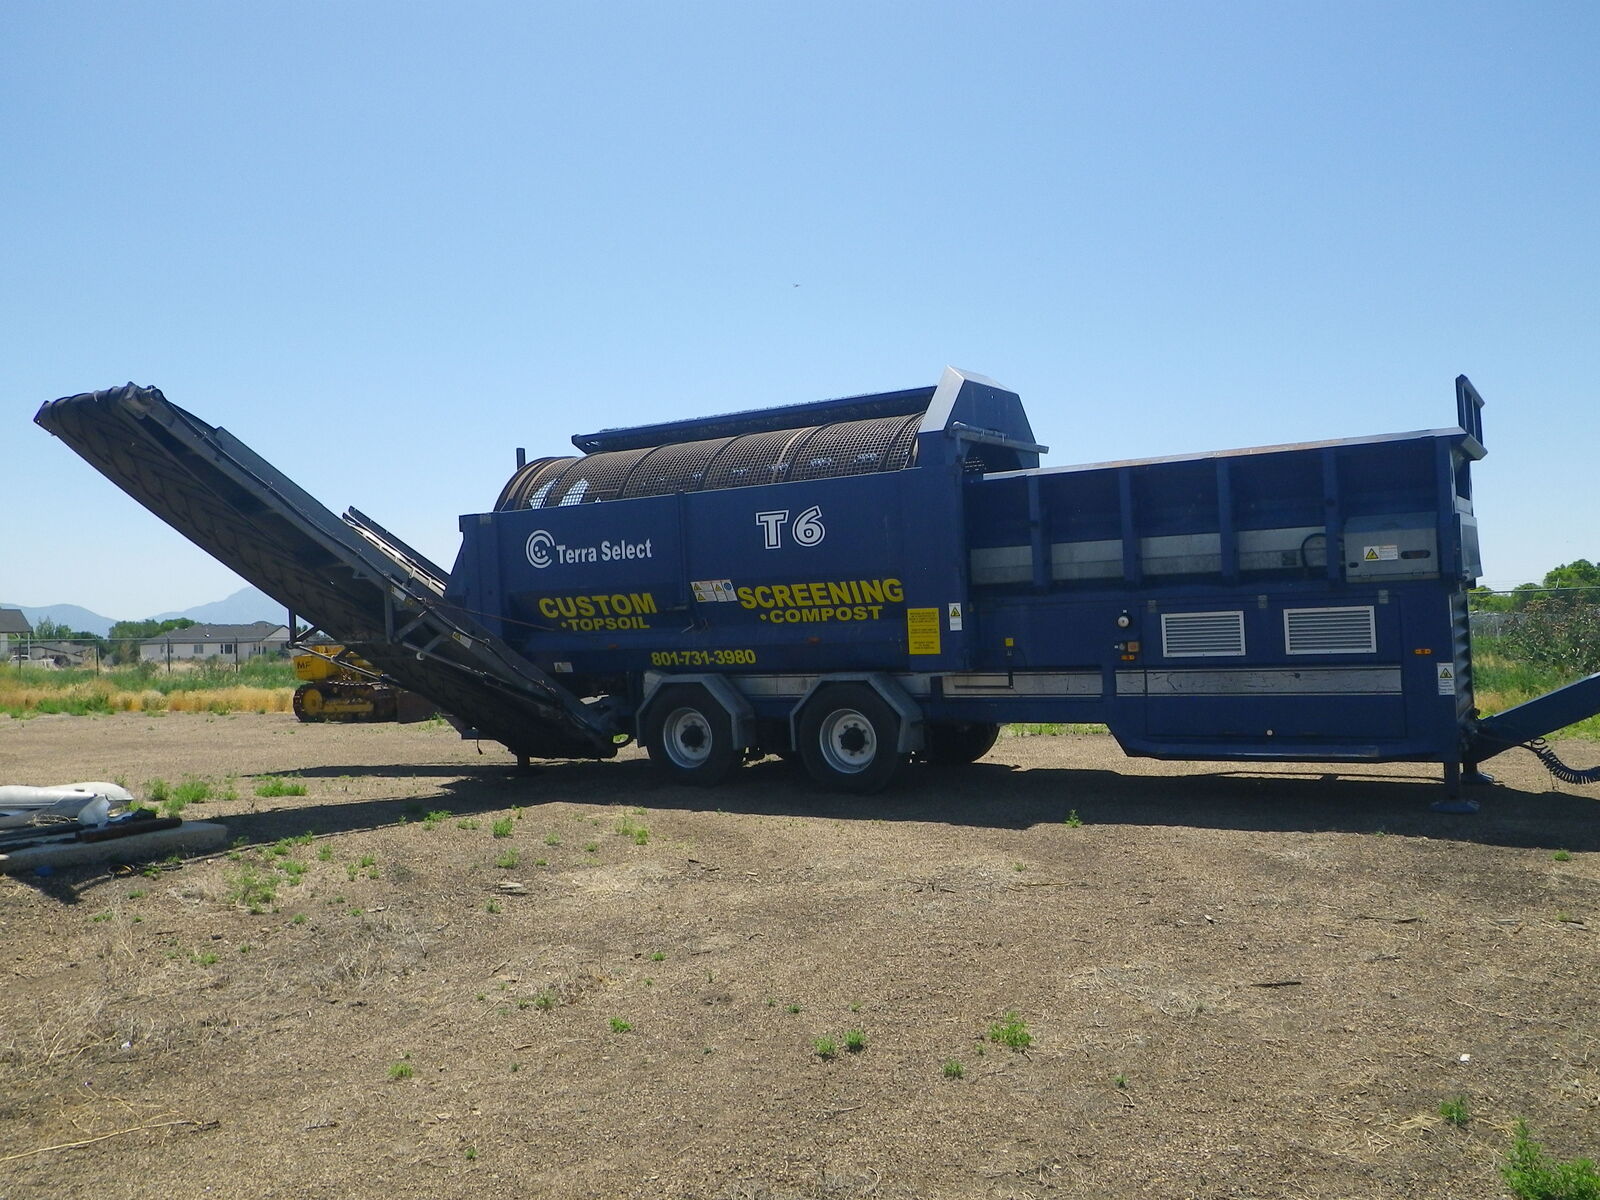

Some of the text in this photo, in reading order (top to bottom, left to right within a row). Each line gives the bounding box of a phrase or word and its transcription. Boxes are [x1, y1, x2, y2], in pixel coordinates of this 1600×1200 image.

[556, 538, 652, 564] Terra Select
[539, 593, 657, 618] CUSTOM
[737, 578, 904, 609] SCREENING
[651, 649, 756, 666] 801-731-3980
